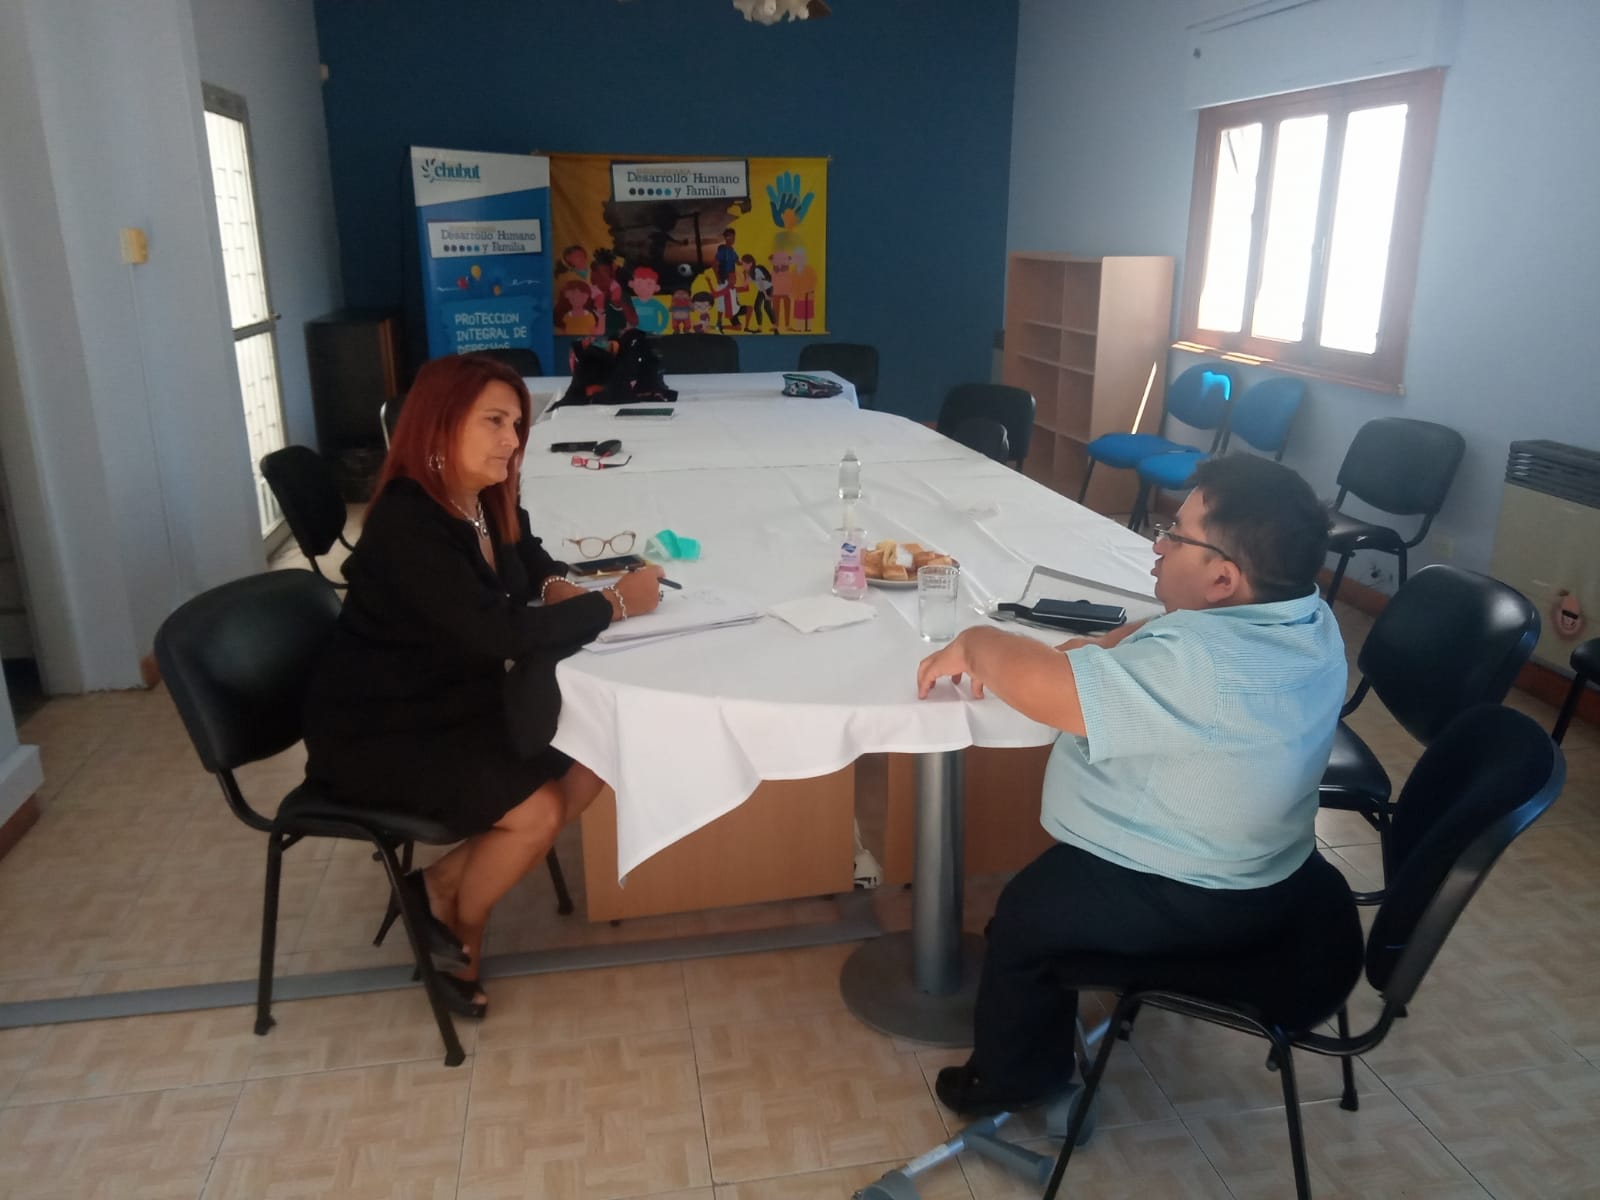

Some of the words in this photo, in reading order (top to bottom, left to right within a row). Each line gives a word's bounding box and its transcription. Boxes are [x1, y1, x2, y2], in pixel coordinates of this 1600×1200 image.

[435, 161, 480, 179] chubut
[627, 171, 688, 184] Desarrollo
[693, 173, 740, 184] Humano
[674, 187, 681, 197] y
[686, 185, 726, 196] Familia
[441, 229, 494, 241] Desarrollo
[497, 230, 537, 241] Humano
[482, 243, 489, 253] y
[492, 241, 526, 252] Familia
[455, 312, 519, 325] PROTECCION
[456, 327, 509, 341] INTEGRAL
[513, 326, 528, 338] DE
